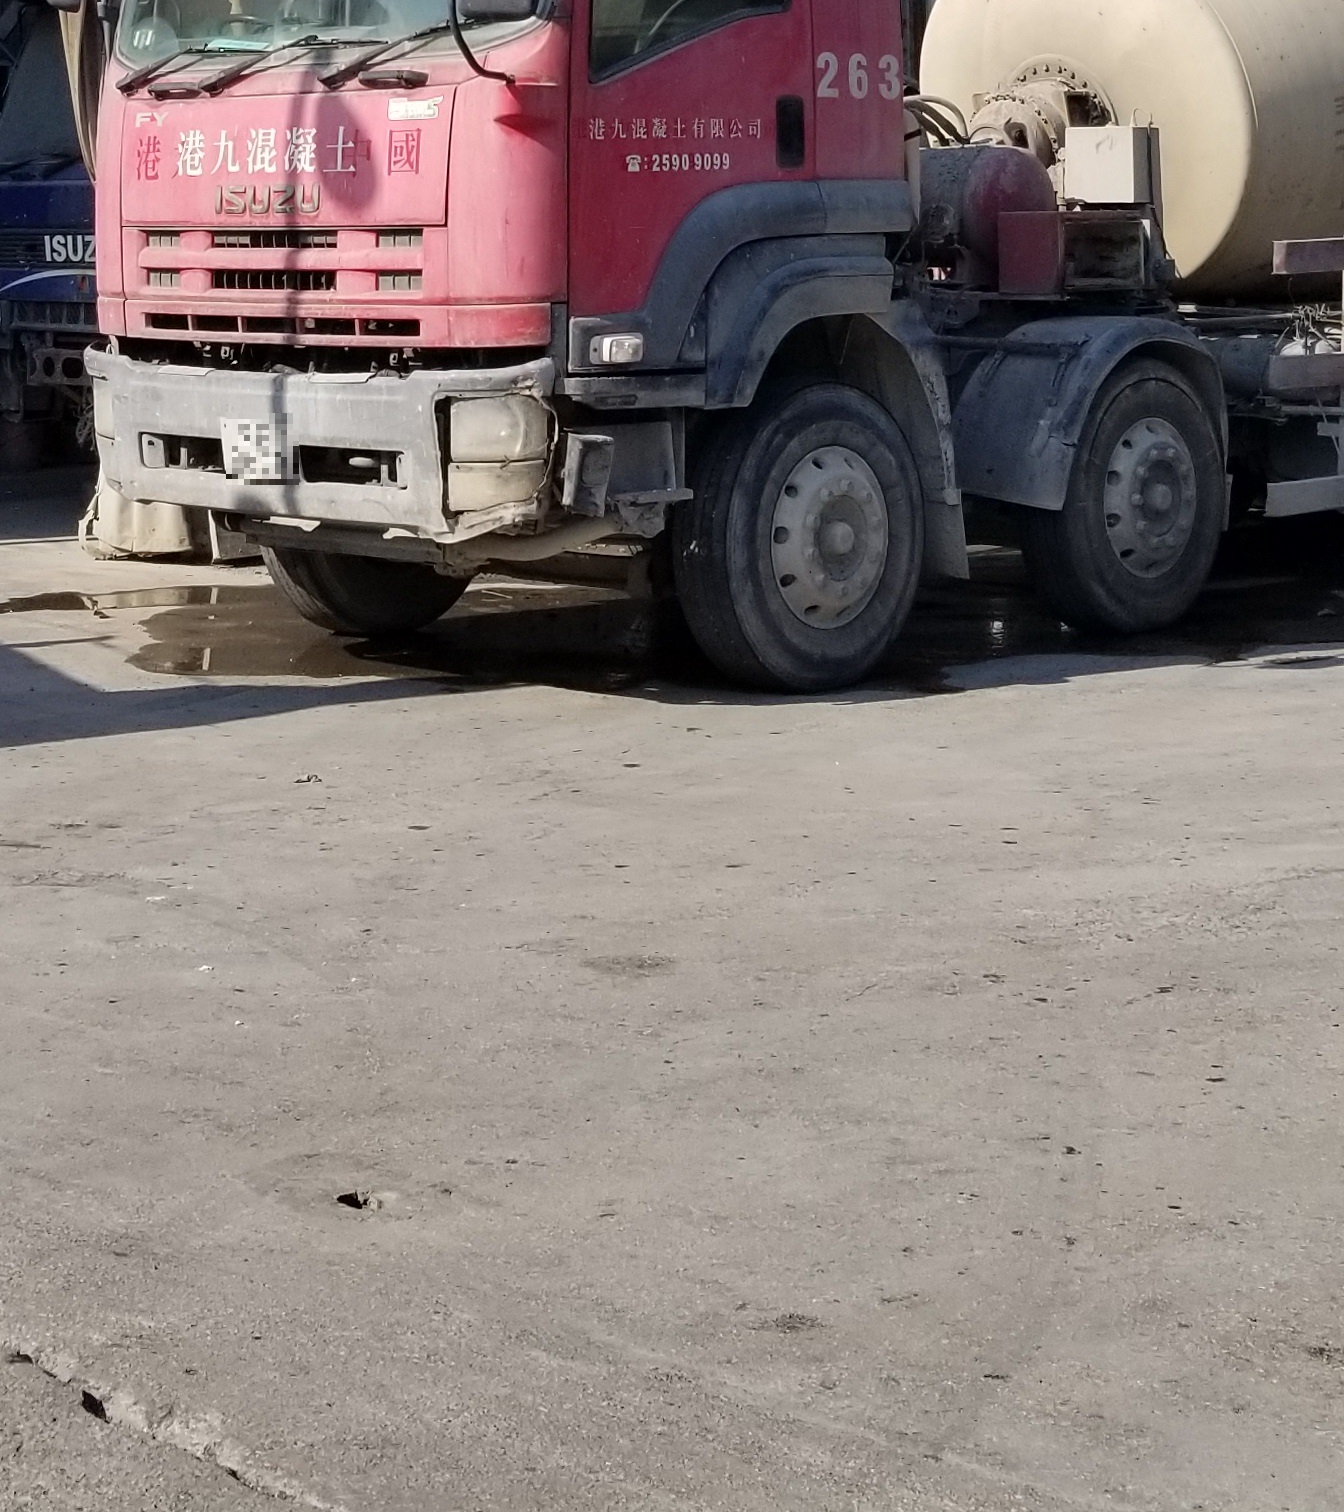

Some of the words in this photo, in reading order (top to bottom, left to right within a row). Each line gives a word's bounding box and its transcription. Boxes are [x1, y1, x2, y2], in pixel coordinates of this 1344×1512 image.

[816, 51, 901, 100] 263
[135, 112, 169, 128] FY
[589, 118, 762, 140] 港九混凝土有限公司
[177, 125, 357, 176] 港九混凝土
[214, 183, 322, 216] ISUZU
